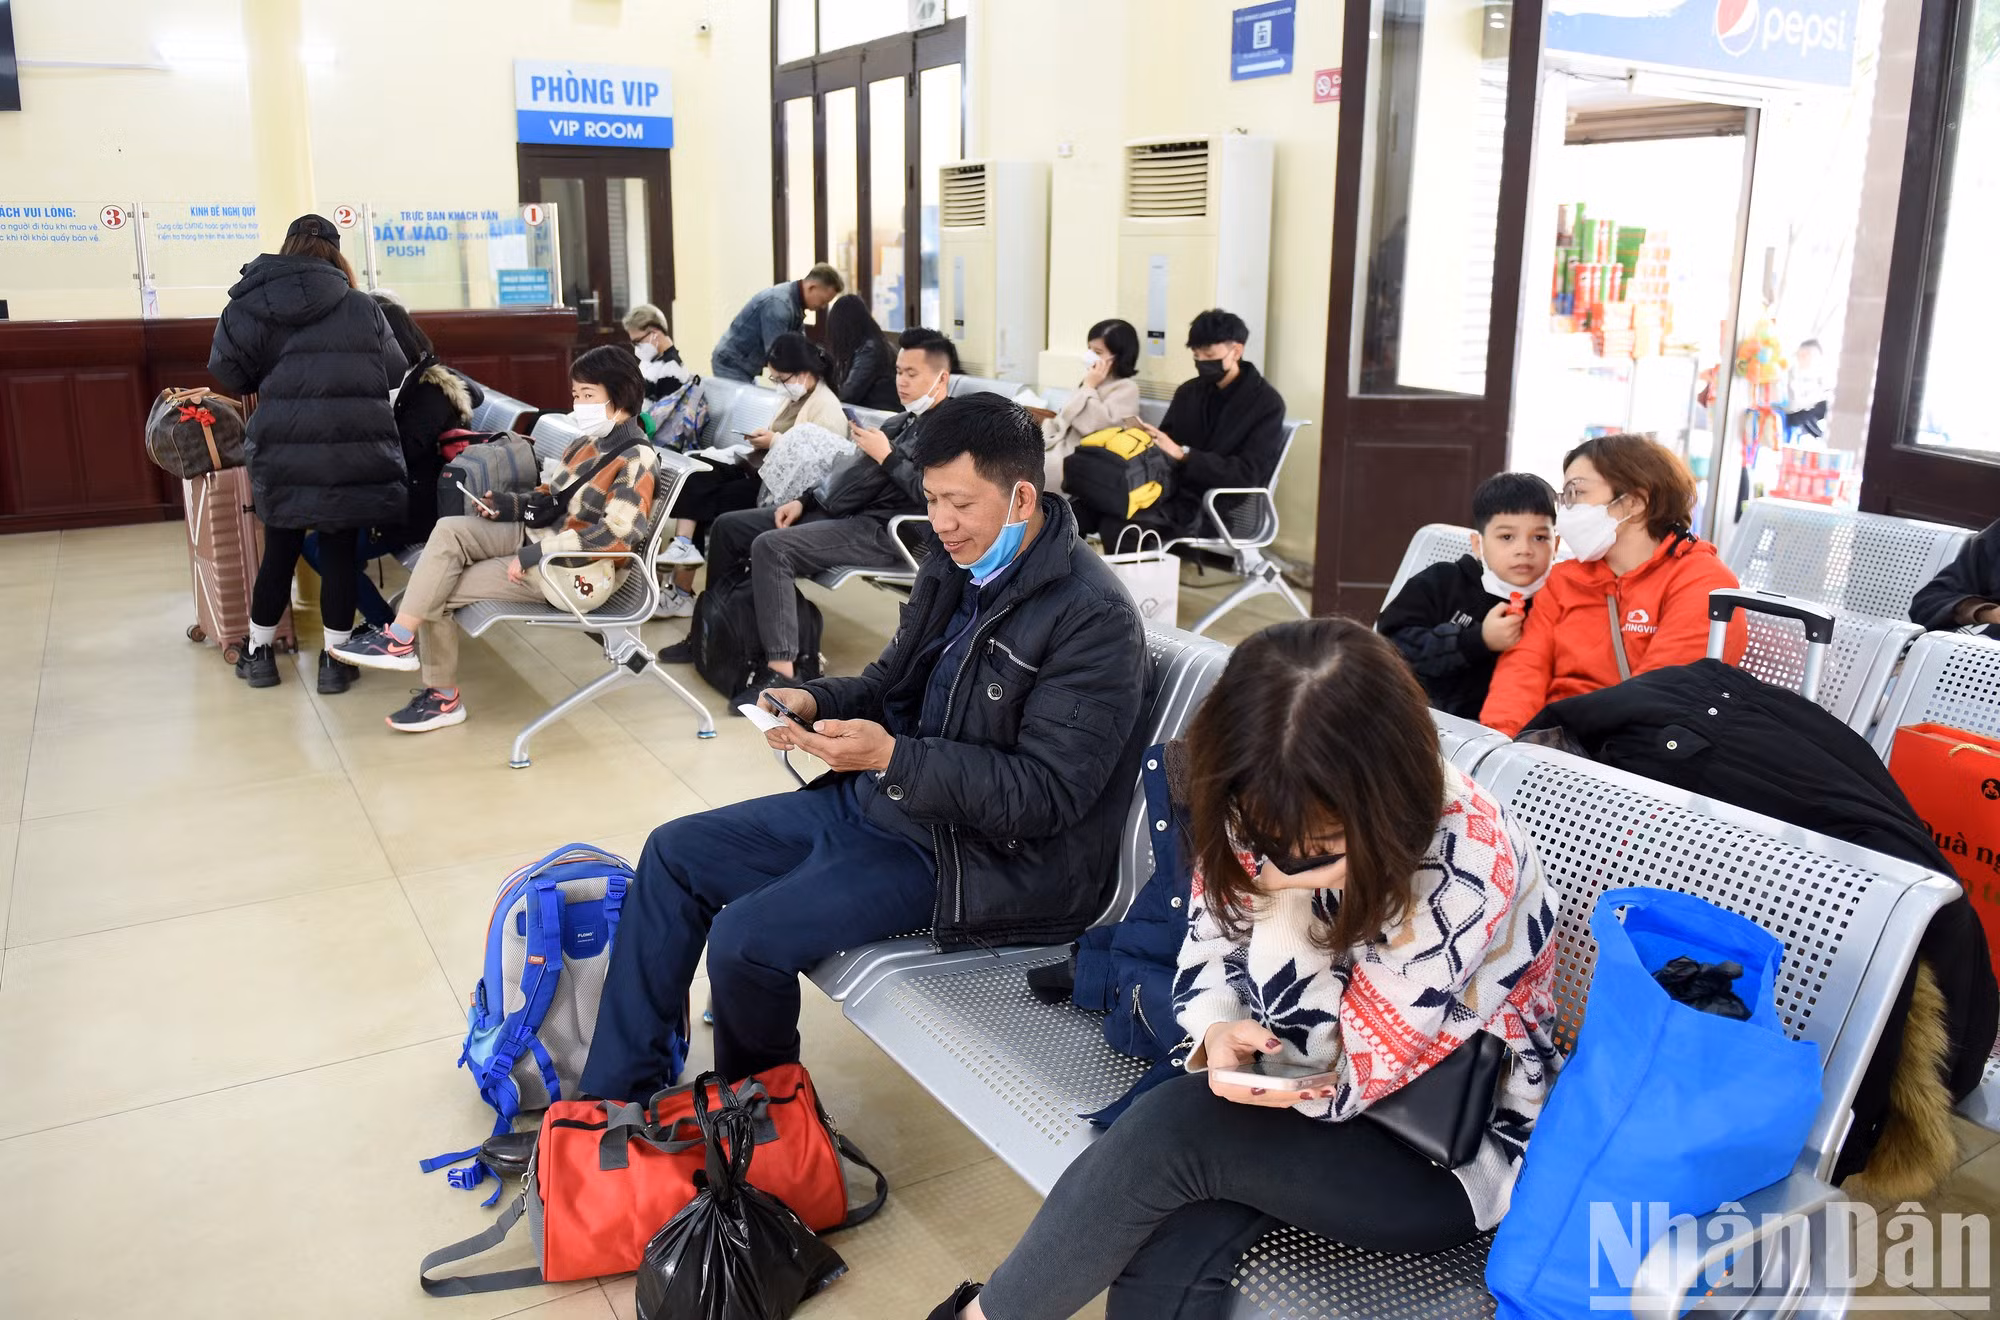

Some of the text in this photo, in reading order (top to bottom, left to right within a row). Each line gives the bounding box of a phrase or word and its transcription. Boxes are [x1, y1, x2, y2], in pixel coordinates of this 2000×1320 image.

[1762, 7, 1847, 58] pepsi
[530, 69, 659, 107] PHÒNG VIP
[549, 119, 644, 140] VIP ROOM
[23, 207, 41, 218] VUI
[106, 209, 121, 226] 3
[340, 209, 351, 225] 2
[426, 211, 445, 221] BAN
[56, 221, 67, 230] khi
[69, 223, 86, 231] mua
[412, 222, 448, 241] VÀO
[386, 246, 426, 257] PUSH
